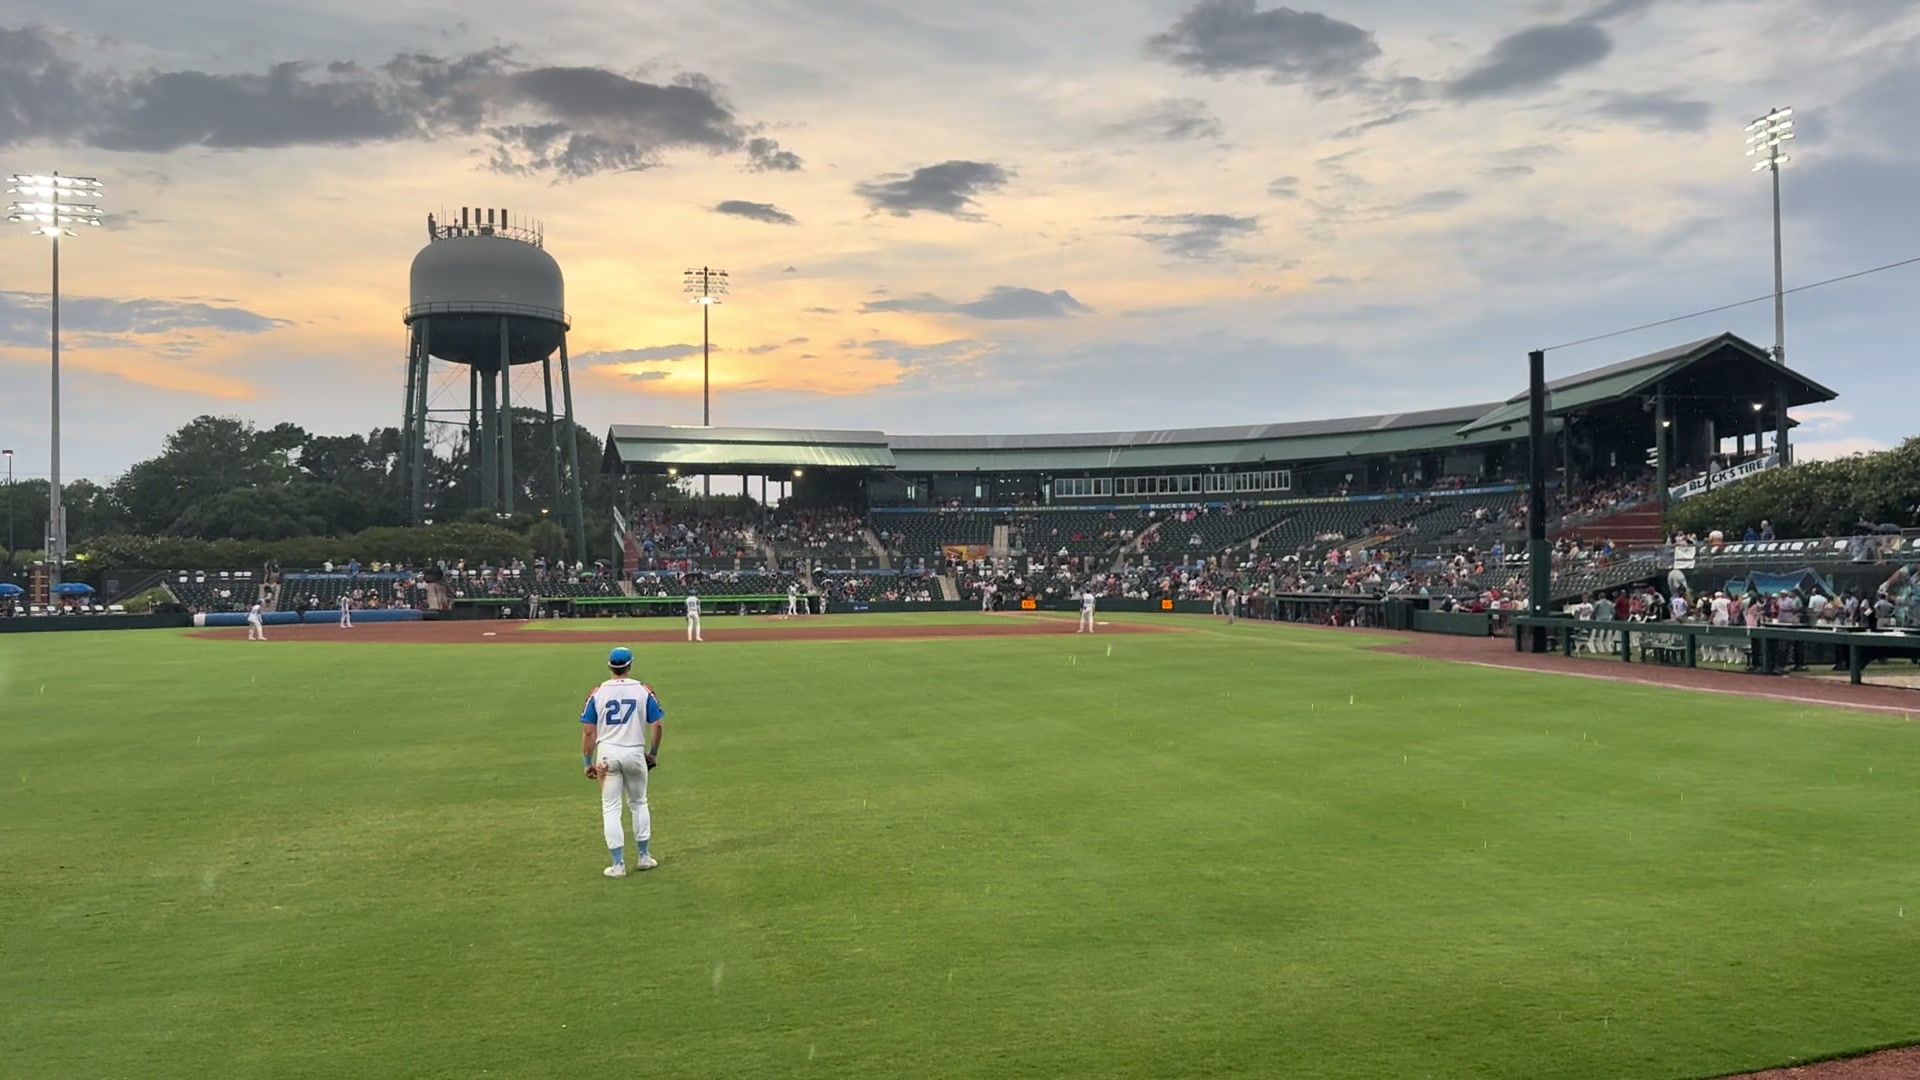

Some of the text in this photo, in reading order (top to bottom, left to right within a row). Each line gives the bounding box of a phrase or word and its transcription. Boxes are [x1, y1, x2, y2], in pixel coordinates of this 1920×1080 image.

[1689, 461, 1764, 491] BLACK'S TIRE
[605, 699, 637, 725] 27
